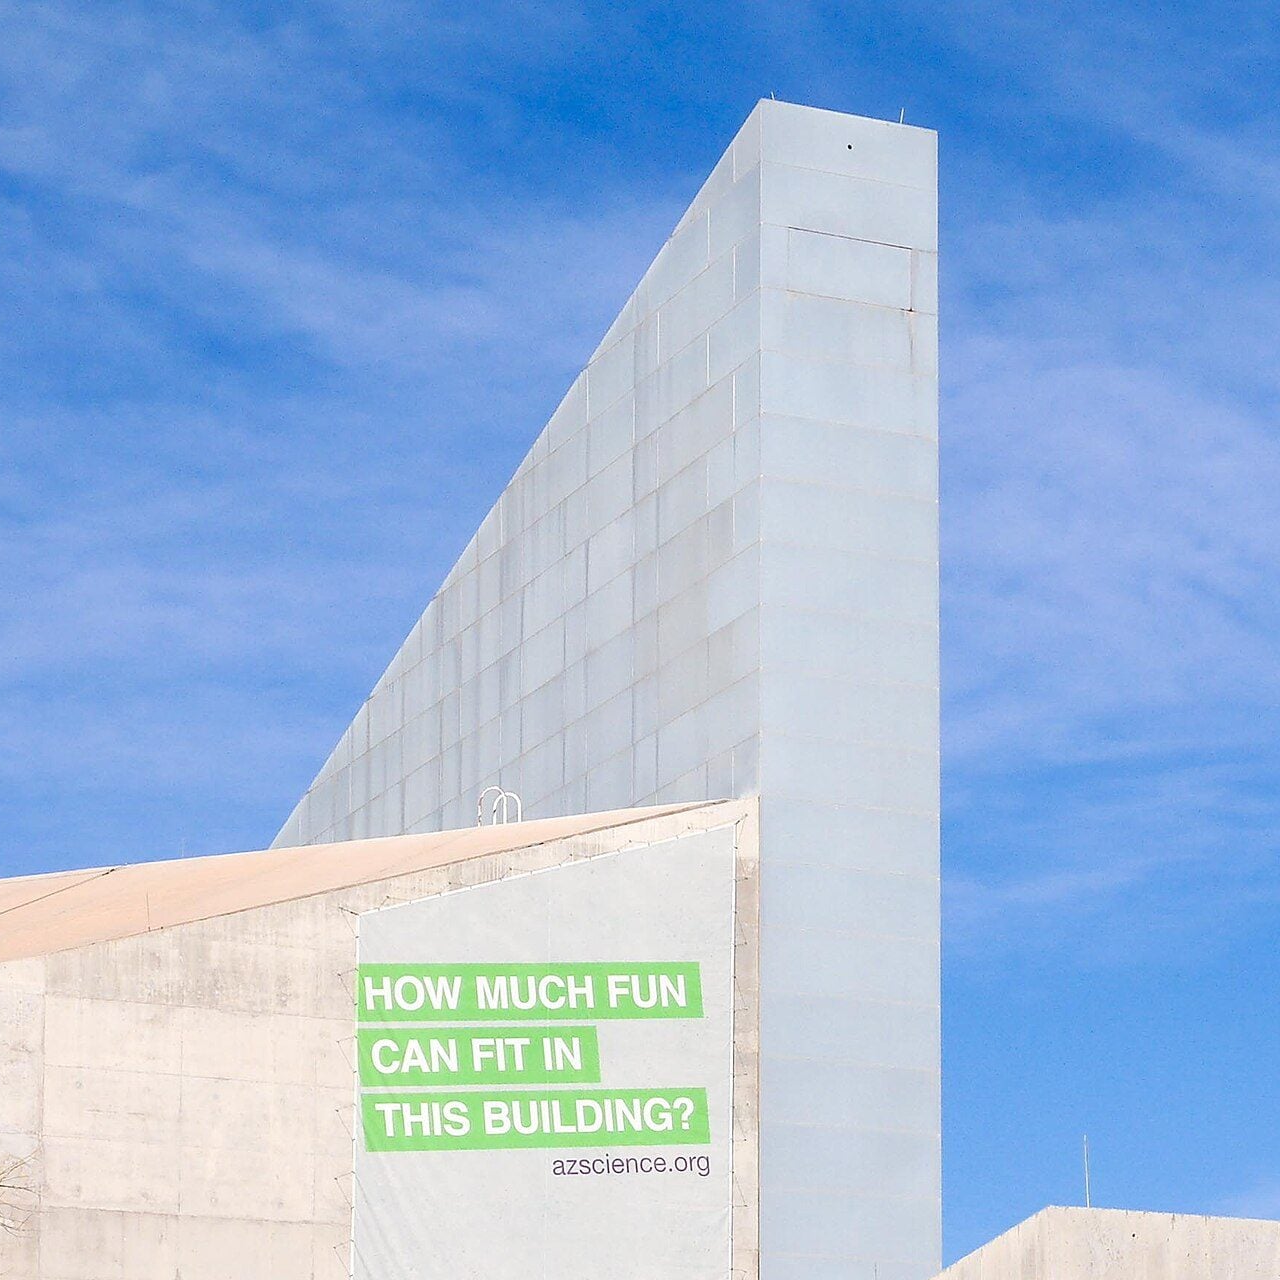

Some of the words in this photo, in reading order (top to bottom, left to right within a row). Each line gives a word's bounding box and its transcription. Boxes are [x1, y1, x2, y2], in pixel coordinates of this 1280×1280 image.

[363, 975, 462, 1011] HOW
[475, 974, 595, 1010] MUCH
[607, 974, 687, 1009] FUN
[371, 1038, 459, 1074] CAN
[471, 1037, 531, 1072] FIT
[542, 1036, 582, 1071] IN
[374, 1100, 471, 1137] THIS
[483, 1096, 695, 1135] BUILDING?
[552, 1152, 710, 1177] azscience.org
